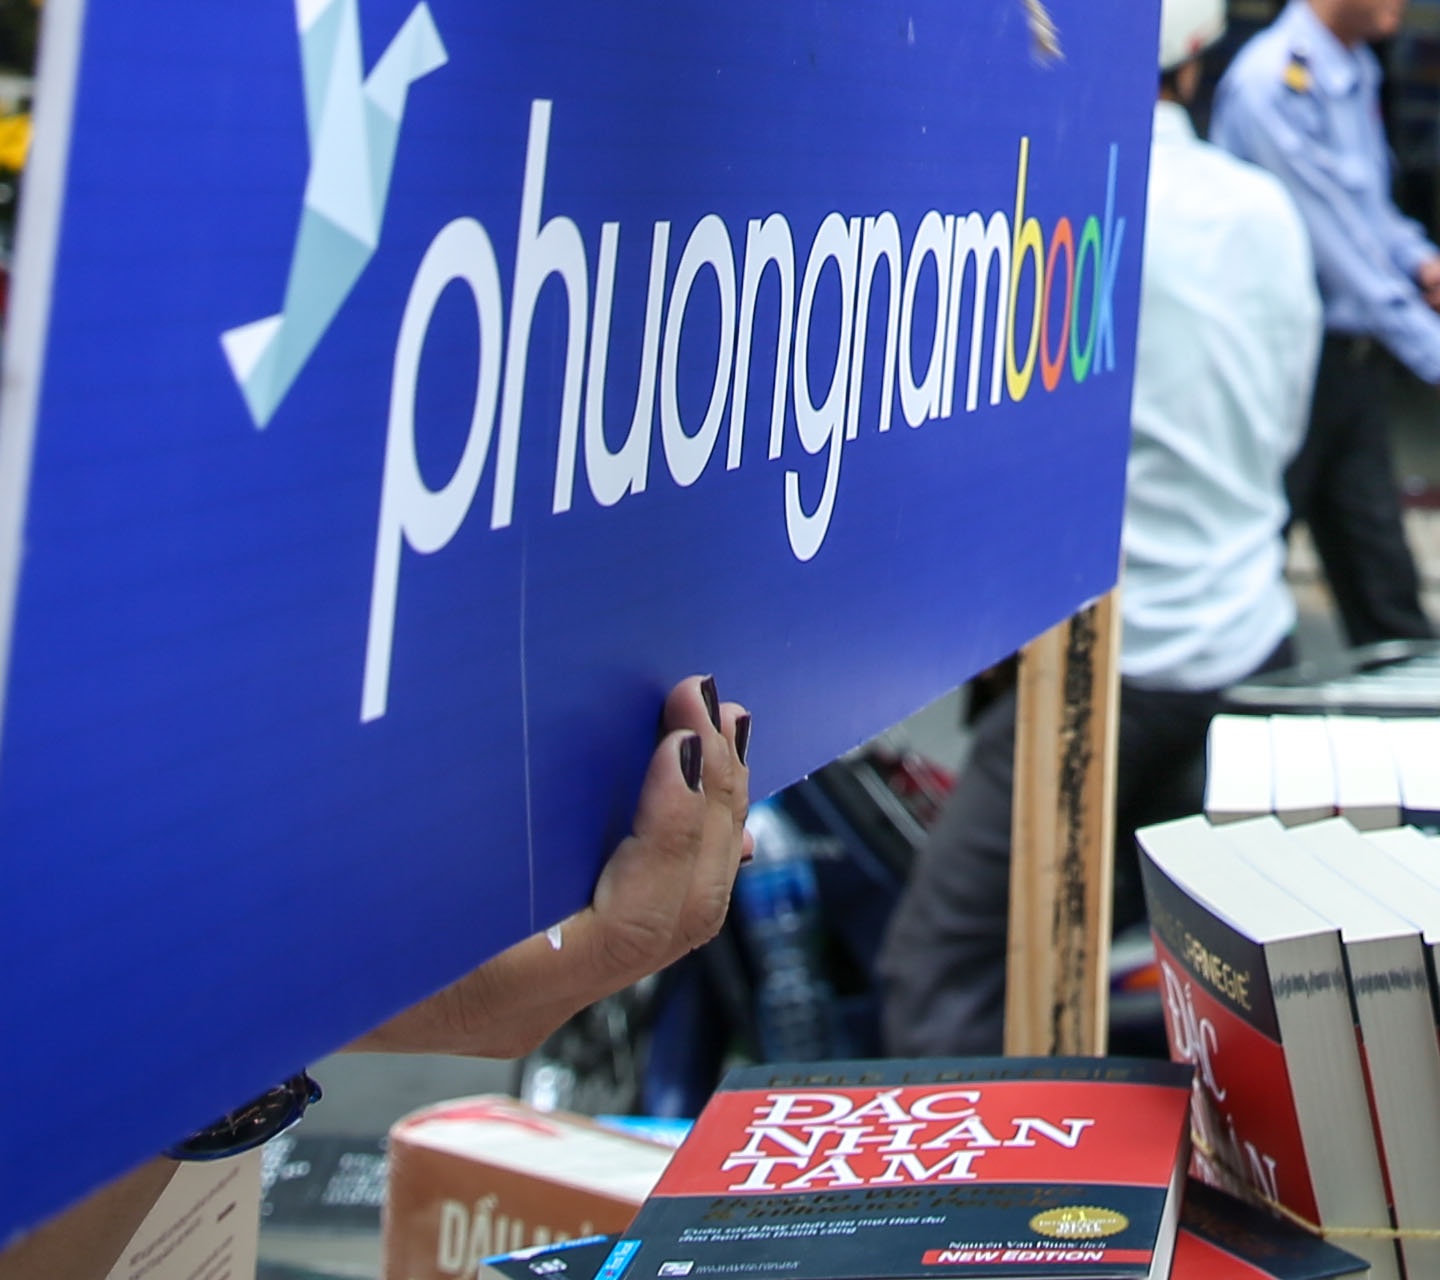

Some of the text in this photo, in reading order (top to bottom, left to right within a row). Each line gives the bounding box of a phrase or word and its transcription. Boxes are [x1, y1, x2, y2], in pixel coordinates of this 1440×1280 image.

[361, 98, 1126, 724] phuongnambook
[937, 1249, 1104, 1263] NEW EDITION
